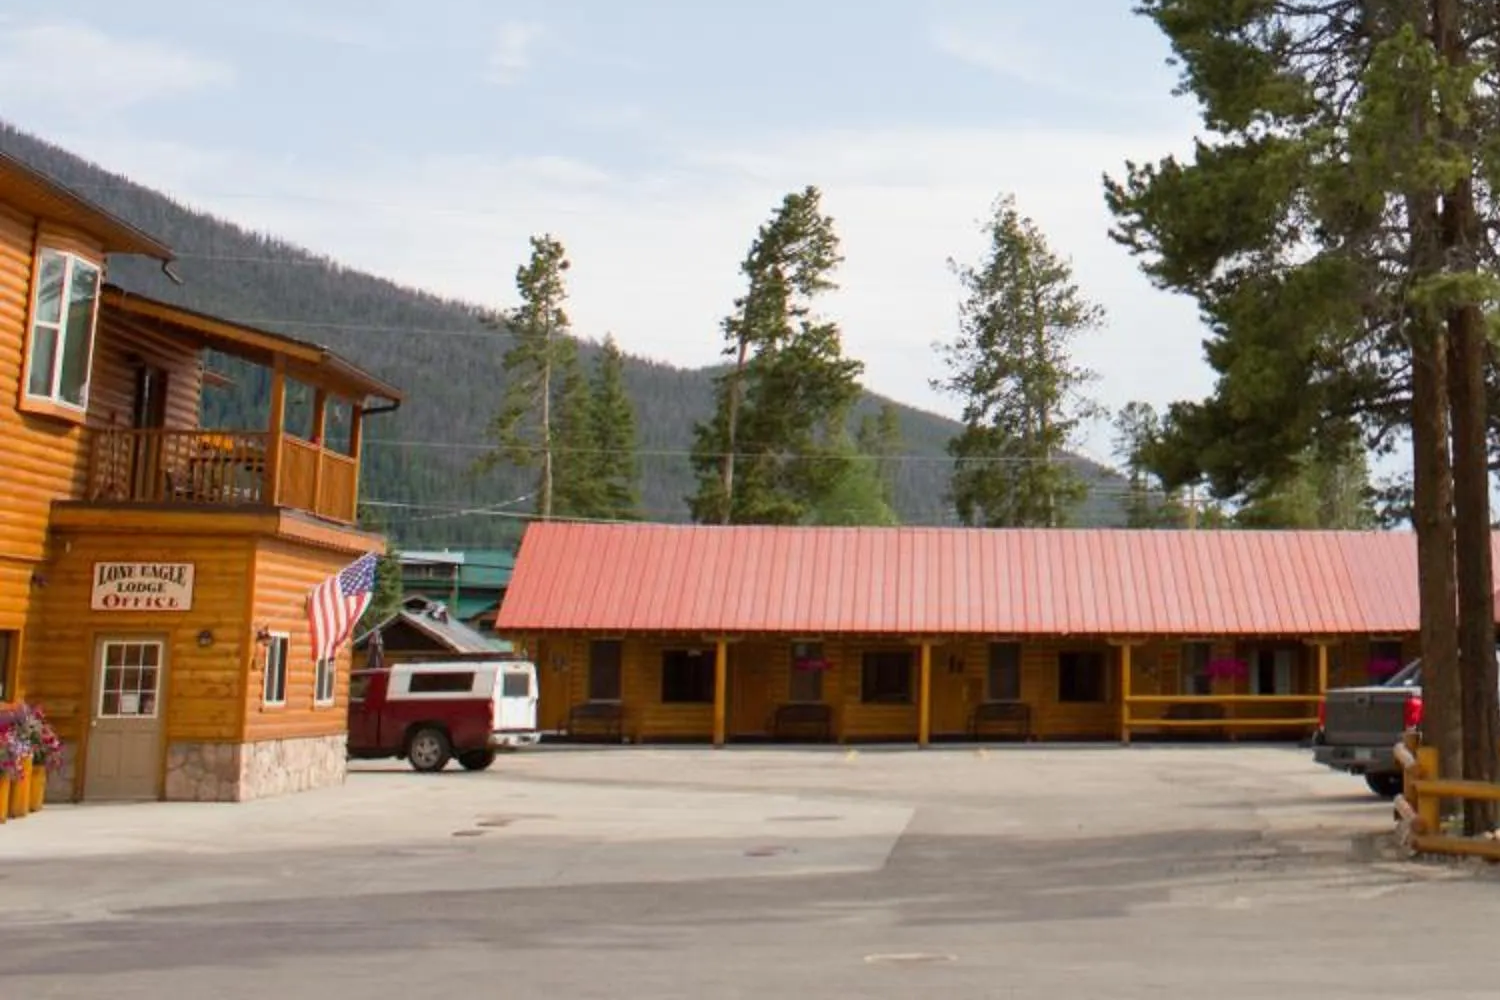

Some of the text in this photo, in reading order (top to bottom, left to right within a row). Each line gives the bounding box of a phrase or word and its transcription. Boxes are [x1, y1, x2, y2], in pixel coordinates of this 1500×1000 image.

[98, 564, 187, 587] LONE EAGLE
[117, 582, 165, 593] LODGE
